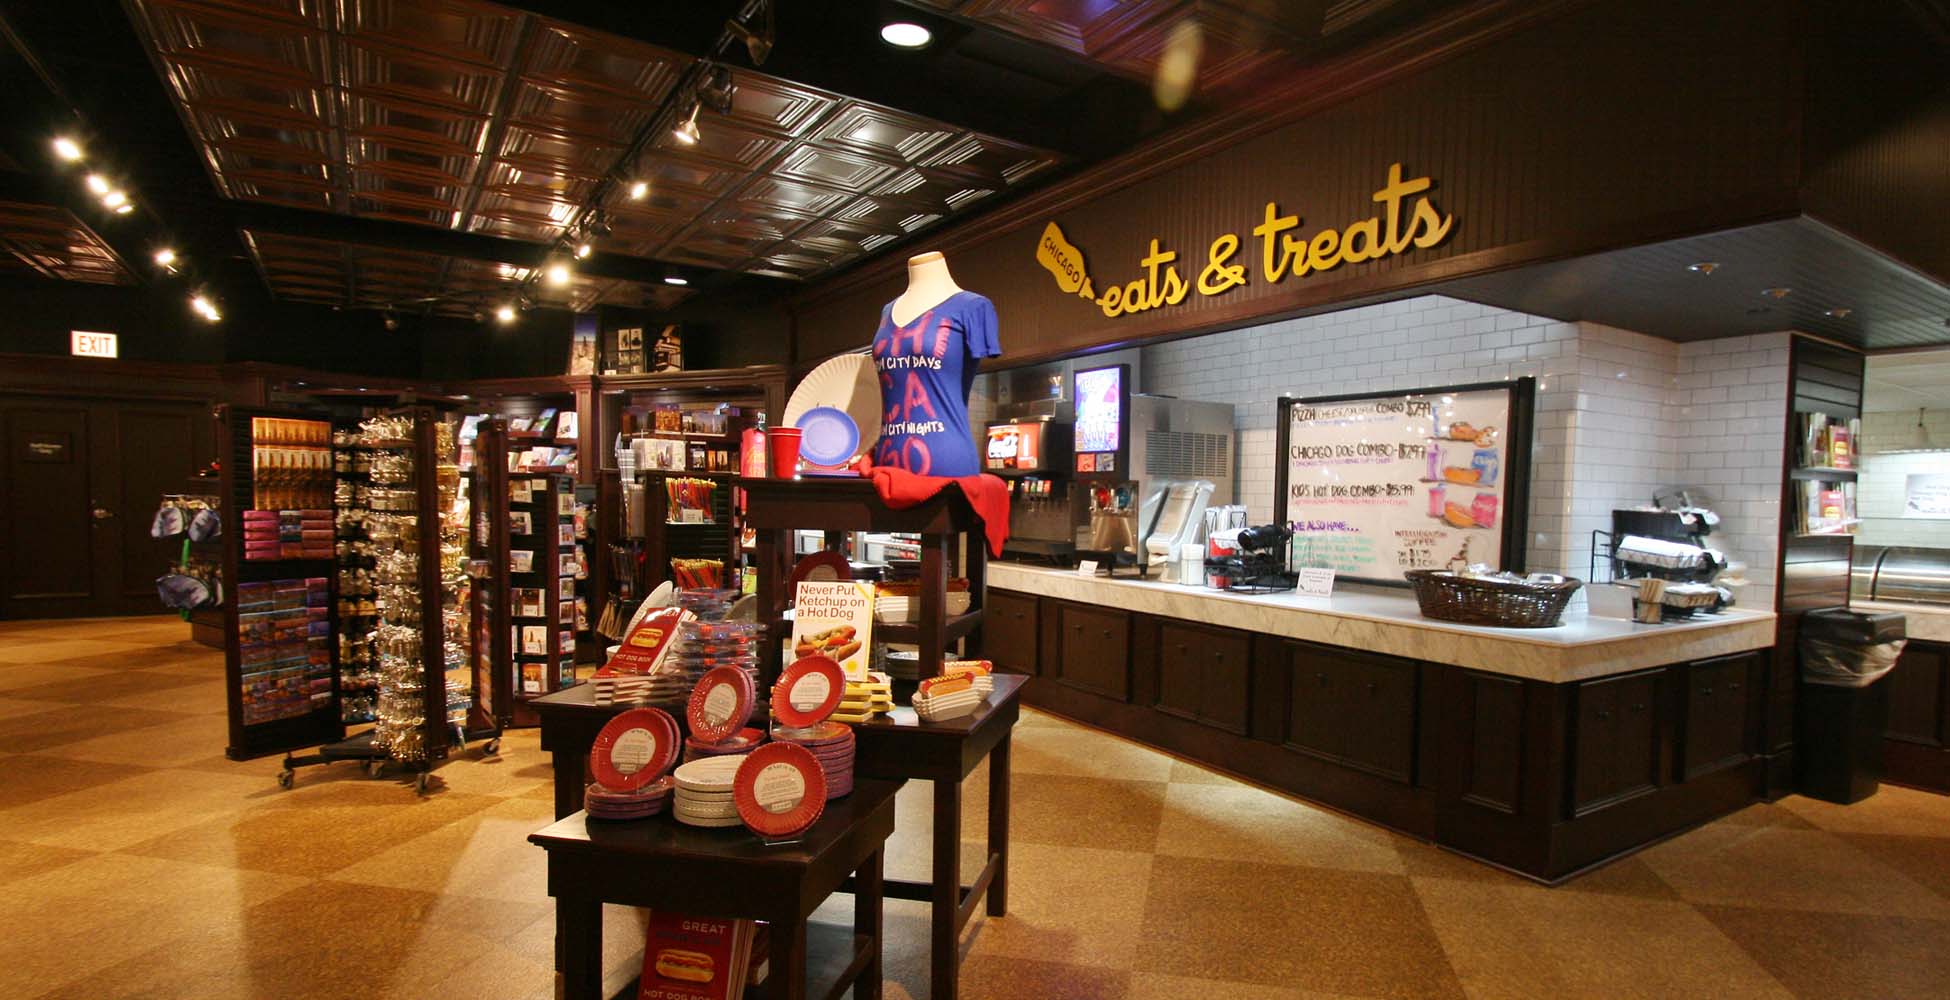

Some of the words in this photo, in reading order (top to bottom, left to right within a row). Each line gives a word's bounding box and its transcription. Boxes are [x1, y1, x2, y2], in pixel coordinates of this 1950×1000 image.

[1096, 238, 1188, 318] eats
[1197, 233, 1247, 296] &
[1253, 162, 1453, 283] treats
[1044, 236, 1081, 284] CHICAGO
[78, 335, 112, 354] EXIT
[886, 355, 910, 370] CITY
[911, 355, 942, 370] DAYS
[888, 421, 906, 436] CITY
[906, 421, 945, 436] NIGHTS
[1291, 445, 1333, 460] CHICAGO
[1335, 445, 1355, 458] DOG
[1291, 483, 1310, 499] KIDS
[1313, 483, 1329, 497] HOT
[1331, 484, 1348, 497] DOG
[1292, 520, 1306, 532] WE
[1306, 520, 1326, 532] ALSO
[800, 584, 835, 596] Never
[836, 585, 856, 596] Put
[799, 595, 848, 609] Ketchup
[850, 599, 865, 608] on
[797, 609, 805, 618] a
[807, 607, 828, 618] Hot
[830, 608, 854, 621] Dog
[682, 920, 727, 935] GREAT
[643, 988, 664, 999] HOT
